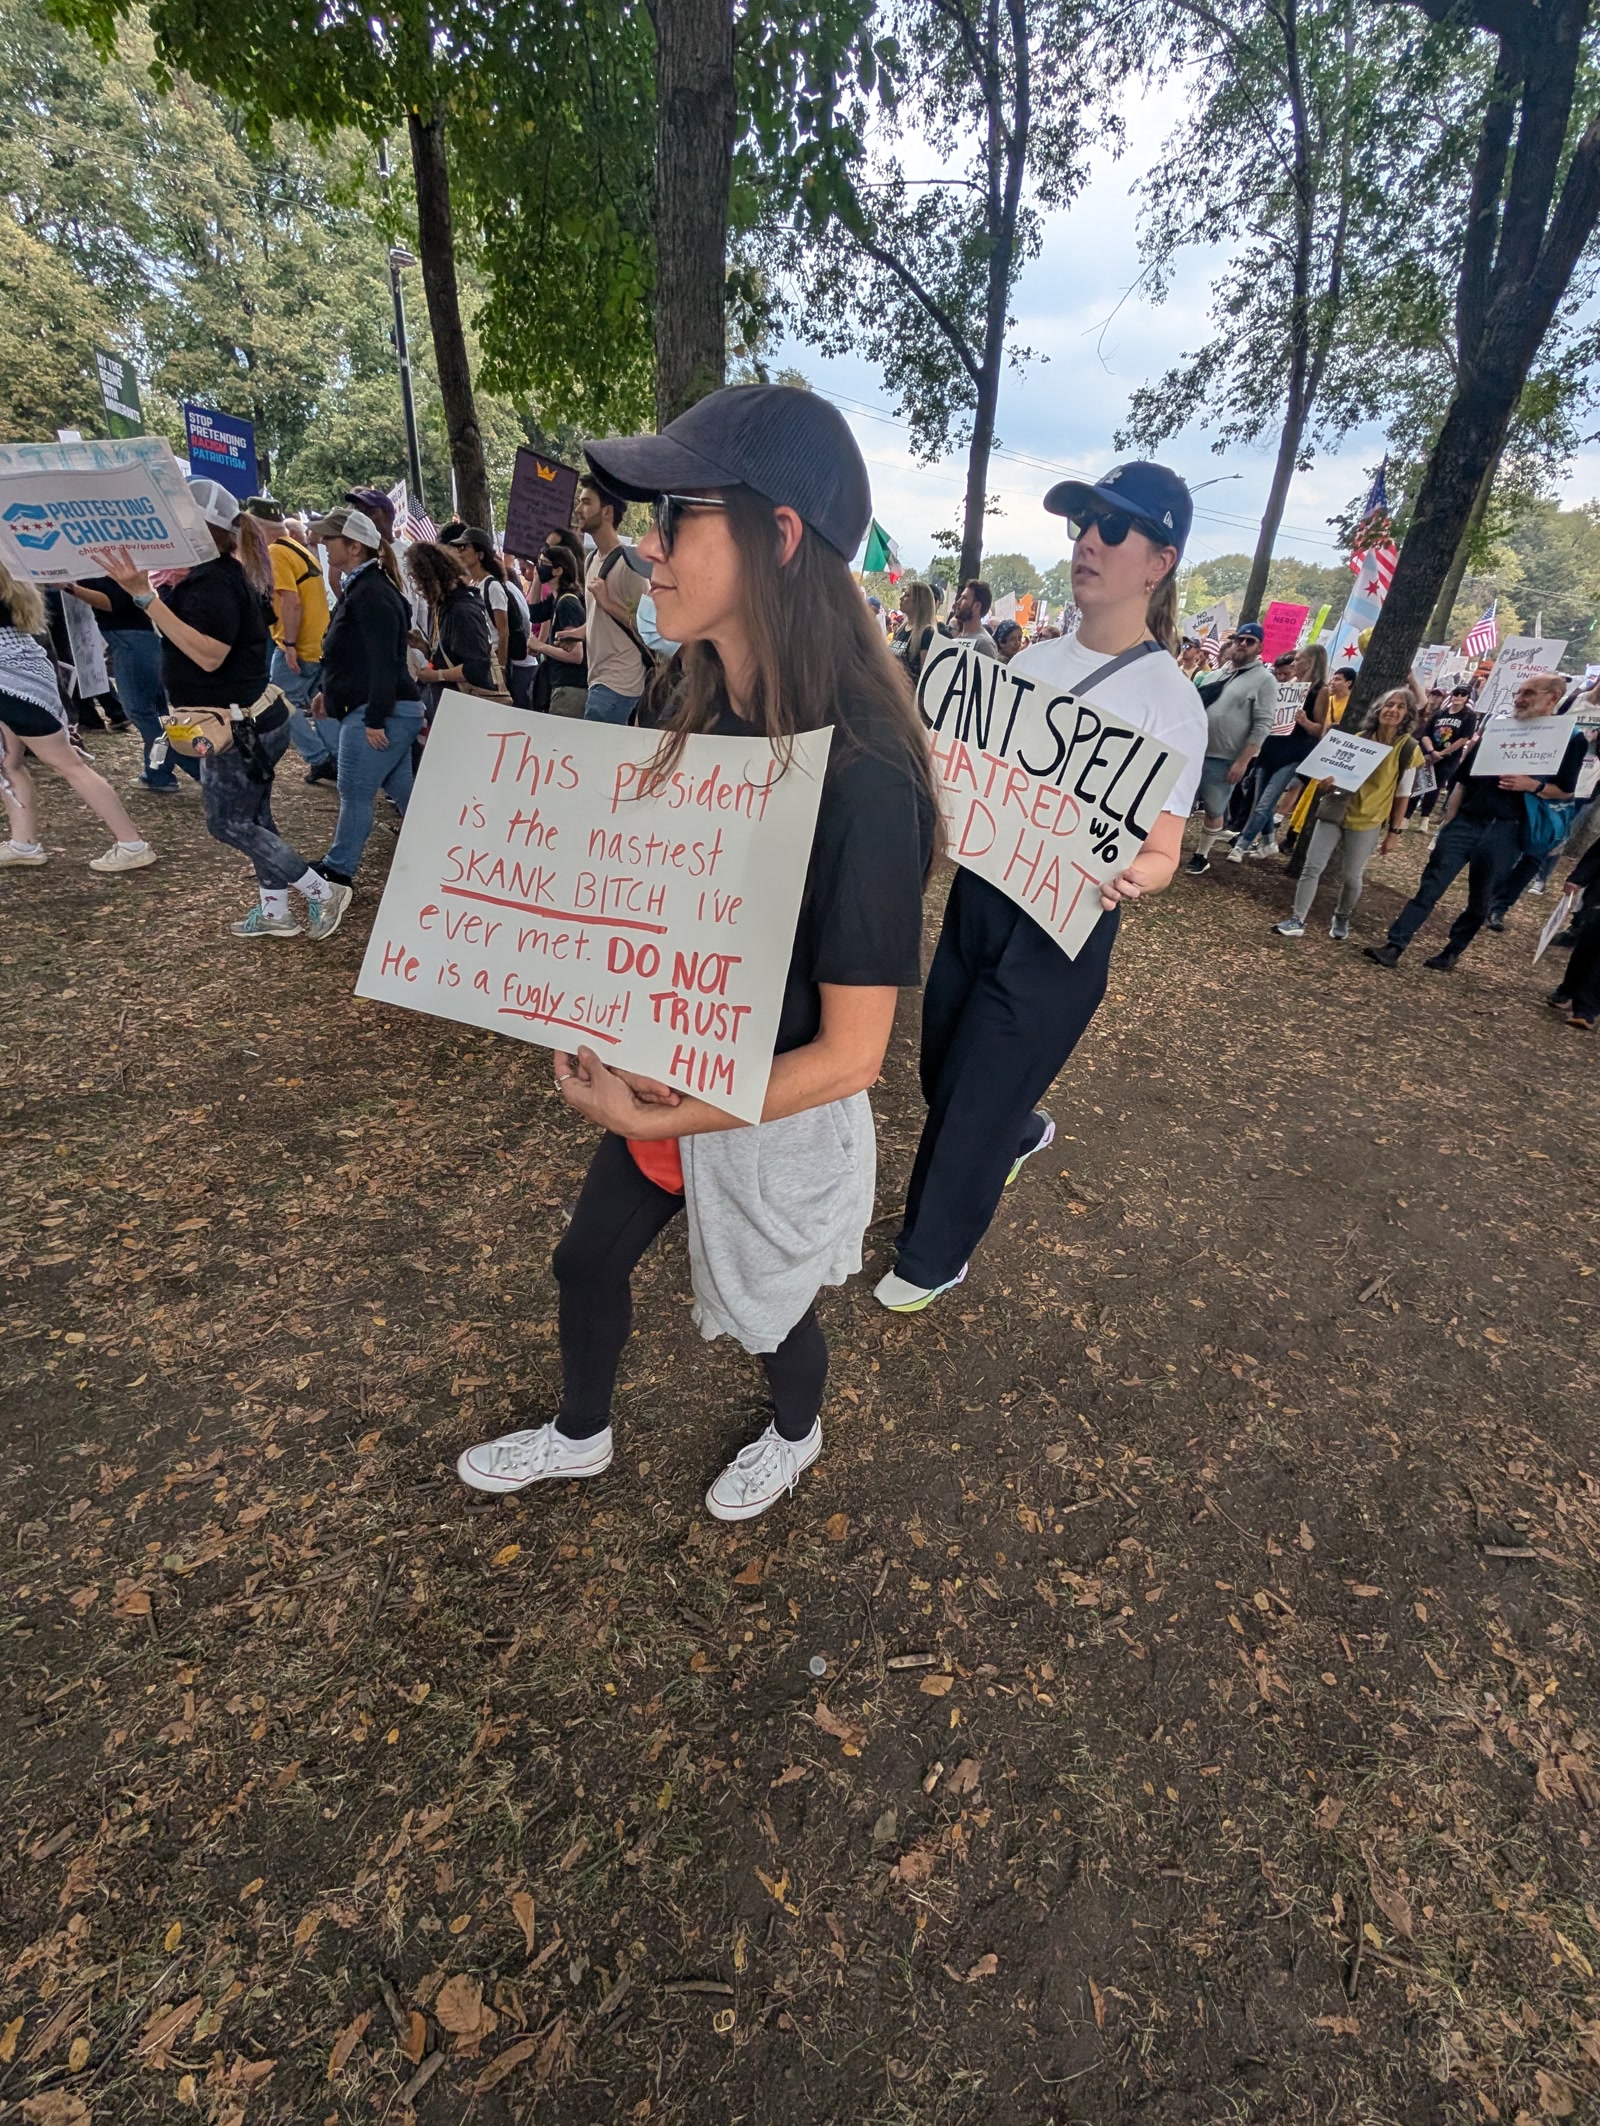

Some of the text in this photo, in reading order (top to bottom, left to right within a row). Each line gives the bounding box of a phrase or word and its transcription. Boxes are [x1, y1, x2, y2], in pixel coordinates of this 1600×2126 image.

[188, 412, 213, 427] STOP
[189, 424, 247, 448] PRETENDING
[191, 434, 239, 457] RACISM IS
[192, 447, 247, 470] PATRIOTISM
[45, 497, 155, 521] PROTECTING
[60, 517, 169, 546] CHICAGO
[1192, 616, 1214, 630] KINGS
[1196, 611, 1208, 620] NO
[1509, 663, 1549, 673] STANDS
[1516, 671, 1538, 679] UNI
[917, 647, 1035, 757] CAN'T
[1277, 687, 1309, 703] STING
[1329, 736, 1378, 756] We like our
[1502, 749, 1557, 760] No Kings!
[1017, 696, 1169, 841] SPELL
[1320, 757, 1356, 771] crushed
[487, 731, 777, 822] This president
[931, 732, 1081, 837] HATRED
[459, 796, 723, 876] is the nastiest
[440, 845, 556, 904] SKANK
[574, 872, 667, 916] BITCH
[1003, 827, 1101, 933] HAT
[419, 903, 743, 996] ever met. DO NOT
[380, 940, 752, 1043] He is a fugly slut! TRUST
[670, 1044, 735, 1095] HIM
